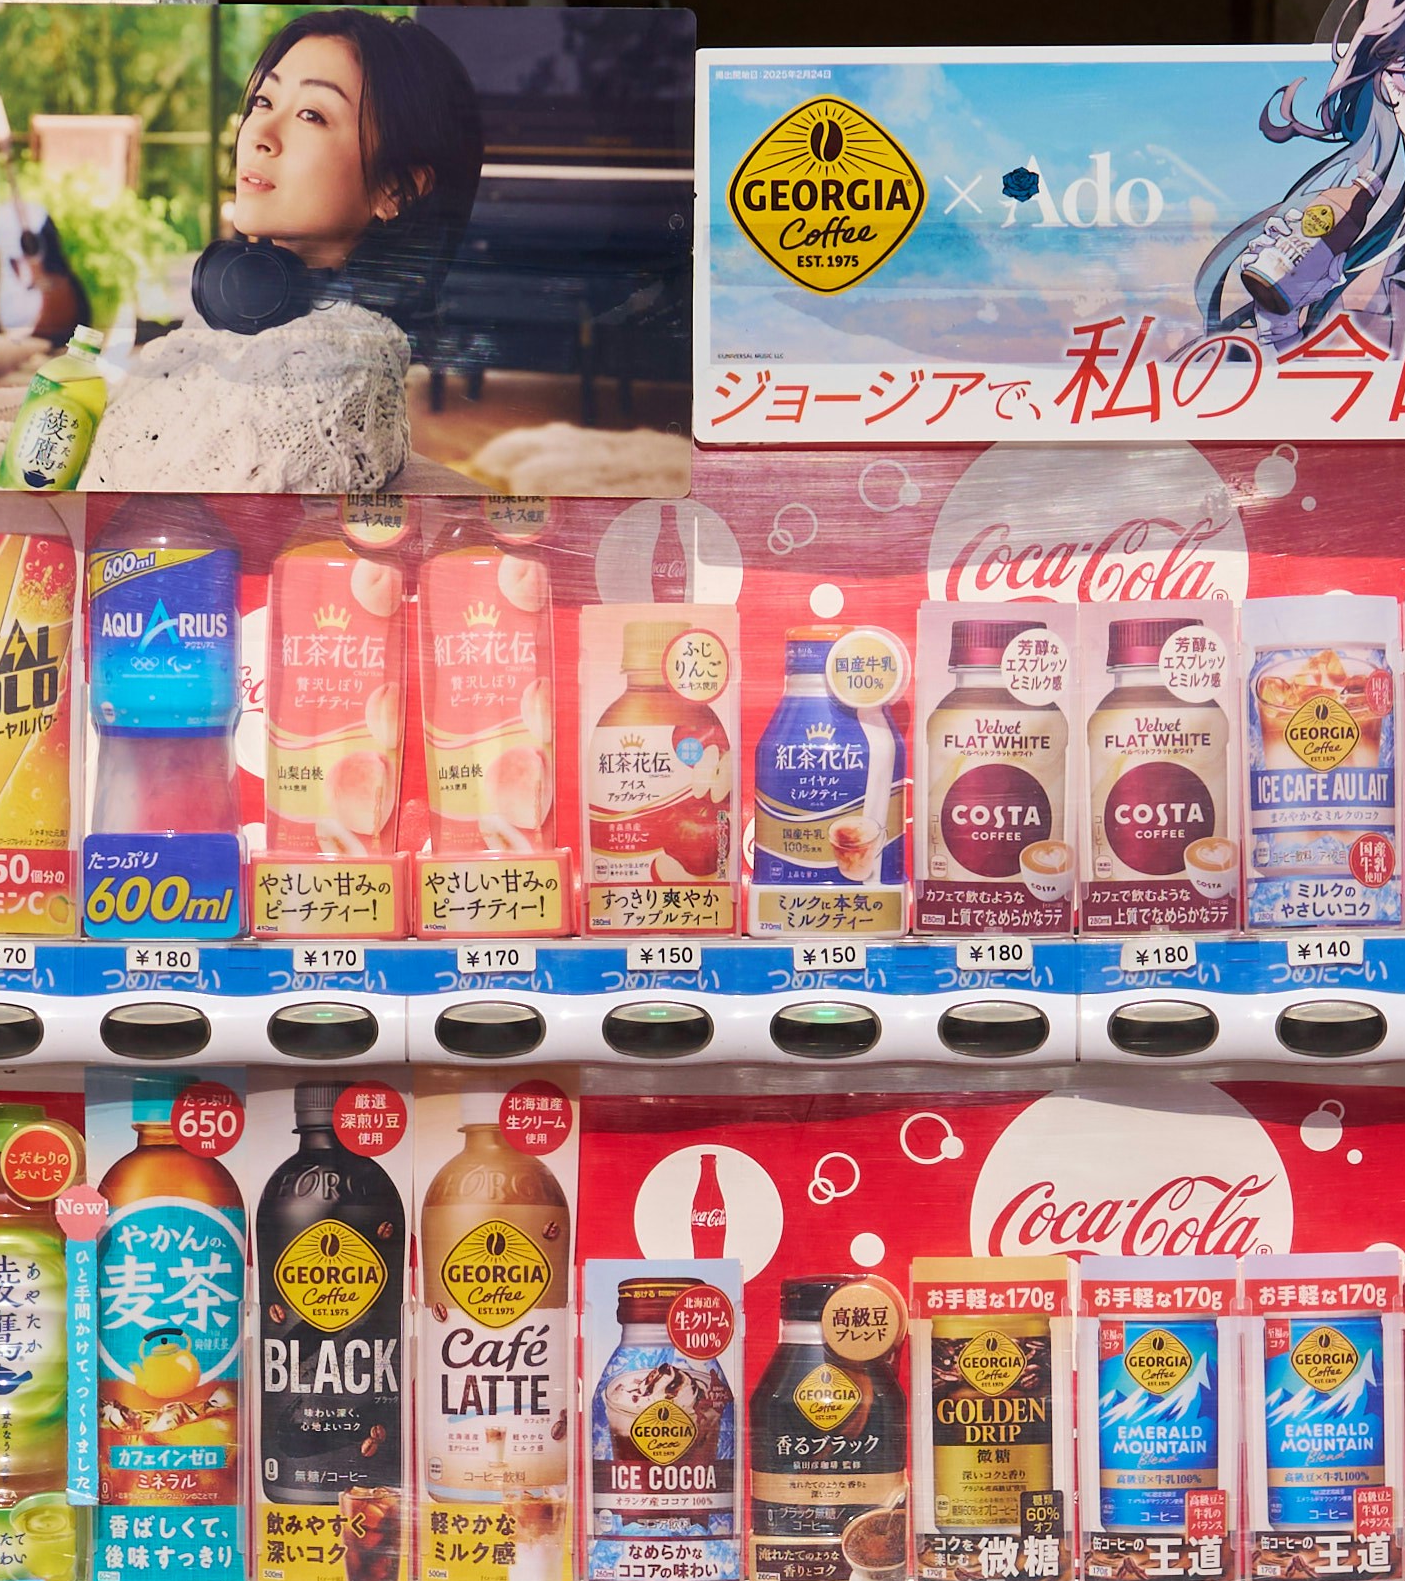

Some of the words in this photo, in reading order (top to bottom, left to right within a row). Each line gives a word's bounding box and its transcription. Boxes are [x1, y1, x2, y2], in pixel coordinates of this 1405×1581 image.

[742, 178, 912, 212] GEORGIA
[1002, 153, 1163, 230] Ado
[779, 219, 879, 251] Coffee
[102, 598, 228, 653] AQUARIUS
[282, 632, 386, 668] 紅茶花伝
[945, 734, 988, 749] FLAT
[992, 734, 1051, 749] WHITE
[776, 743, 865, 770] 紅茶花伝
[1258, 776, 1281, 803] ICE
[1283, 775, 1327, 802] CAFE
[1332, 774, 1356, 801] AU
[1359, 773, 1389, 799] LAIT
[951, 804, 1042, 829] COSTA
[971, 830, 1022, 842] COFFEE
[259, 872, 390, 896] やさしい甘みの
[86, 878, 233, 923] 600ml
[264, 898, 378, 922] ピーチティー!
[601, 890, 720, 910] すっきり爽やか
[777, 895, 883, 913] ミルクに本気の
[948, 906, 1063, 926] 上質でなめらかなラテ
[135, 950, 191, 968] ¥180
[305, 949, 357, 967] ¥170
[970, 944, 1023, 962] ¥180
[56, 1196, 110, 1217] New!
[102, 1256, 238, 1329] 麦茶
[927, 1288, 1054, 1310] お手軽な170g
[442, 1326, 548, 1371] Café
[73, 1250, 94, 1501] ひと手間かけて、つくりました。
[265, 1338, 397, 1394] BLACK
[443, 1374, 550, 1416] LATTE
[937, 1398, 1046, 1423] GOLDEN
[965, 1423, 1021, 1444] DRIP
[1117, 1426, 1202, 1439] EMERALD
[118, 1450, 217, 1466] カフェインゼロ
[1113, 1440, 1207, 1454] MOUNTAIN
[611, 1465, 644, 1490] ICE
[649, 1464, 717, 1490] COCOA
[105, 1545, 233, 1570] 後味すっきり
